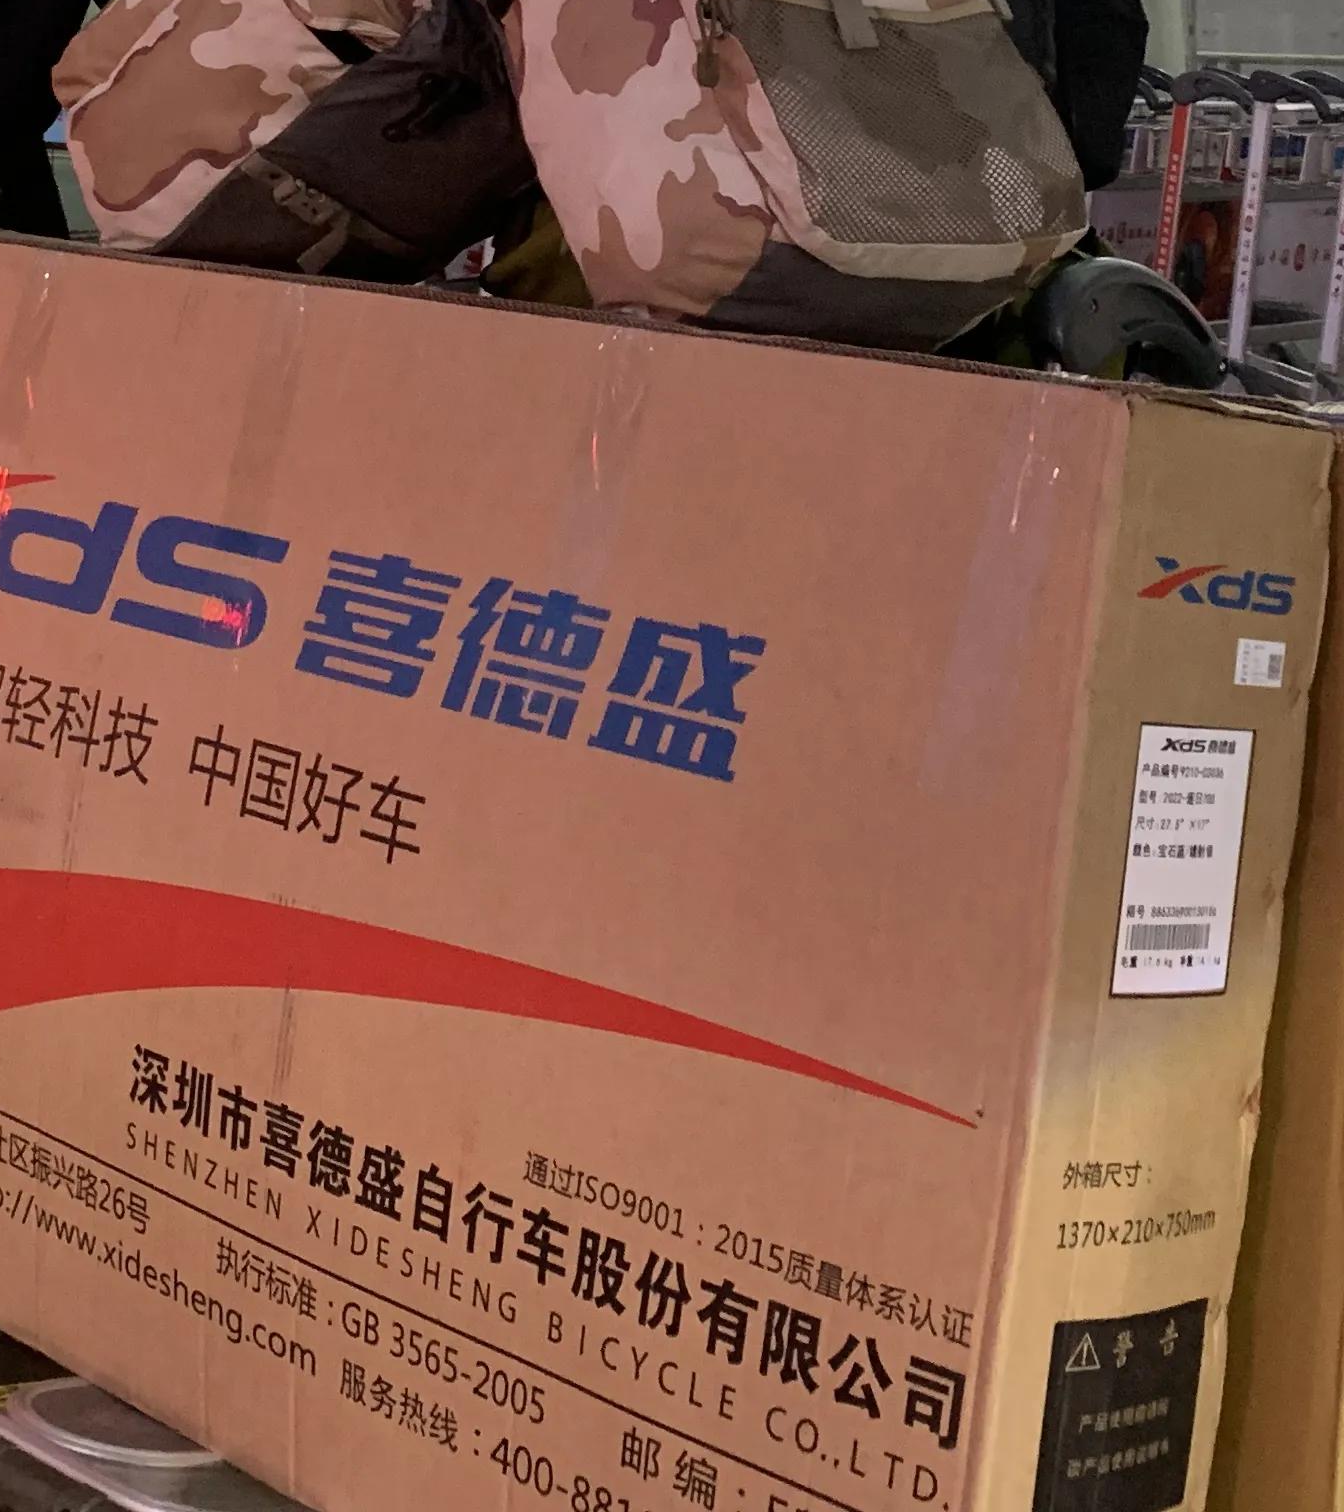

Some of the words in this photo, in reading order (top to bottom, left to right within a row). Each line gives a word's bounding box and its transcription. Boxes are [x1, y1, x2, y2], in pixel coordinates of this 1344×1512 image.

[188, 724, 426, 864] 中国好车
[294, 551, 766, 782] 喜德盛
[126, 1122, 283, 1220] SHENZHEN
[306, 1205, 518, 1324] XIDESHENG
[547, 1313, 737, 1420] BICYCLE
[129, 1043, 967, 1452] 深圳市喜德盛自行车股份有限公司
